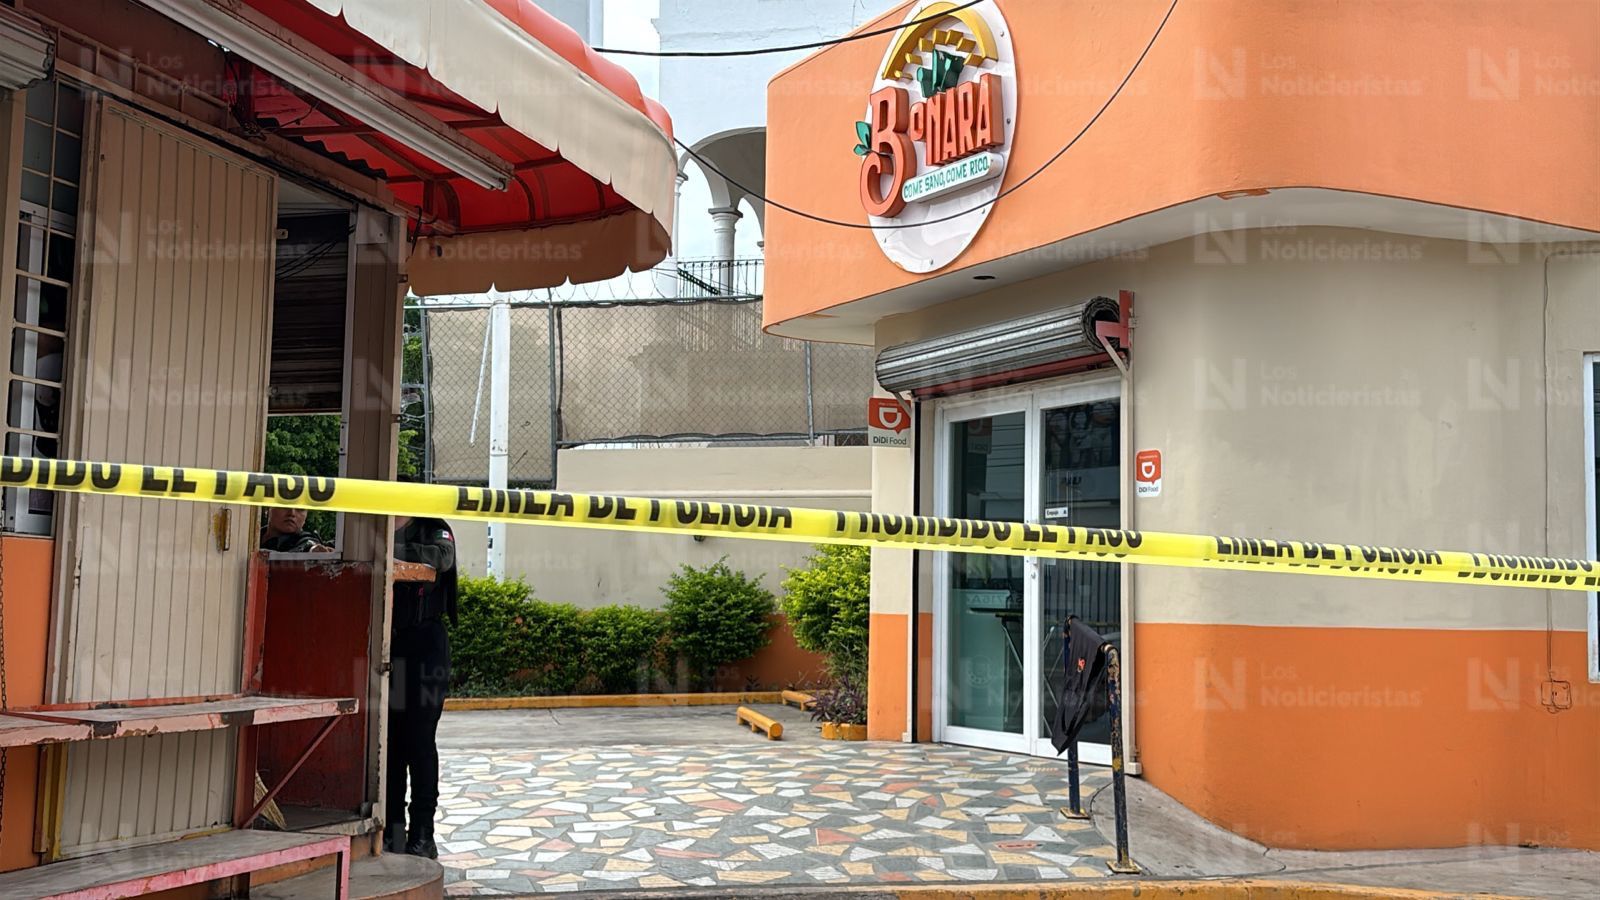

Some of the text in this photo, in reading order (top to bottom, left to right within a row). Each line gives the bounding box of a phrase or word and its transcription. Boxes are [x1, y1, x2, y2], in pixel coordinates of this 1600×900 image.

[860, 73, 1004, 218] BONARA
[903, 156, 990, 198] COME SANO, COME RICO.
[873, 436, 907, 445] DiDi Food
